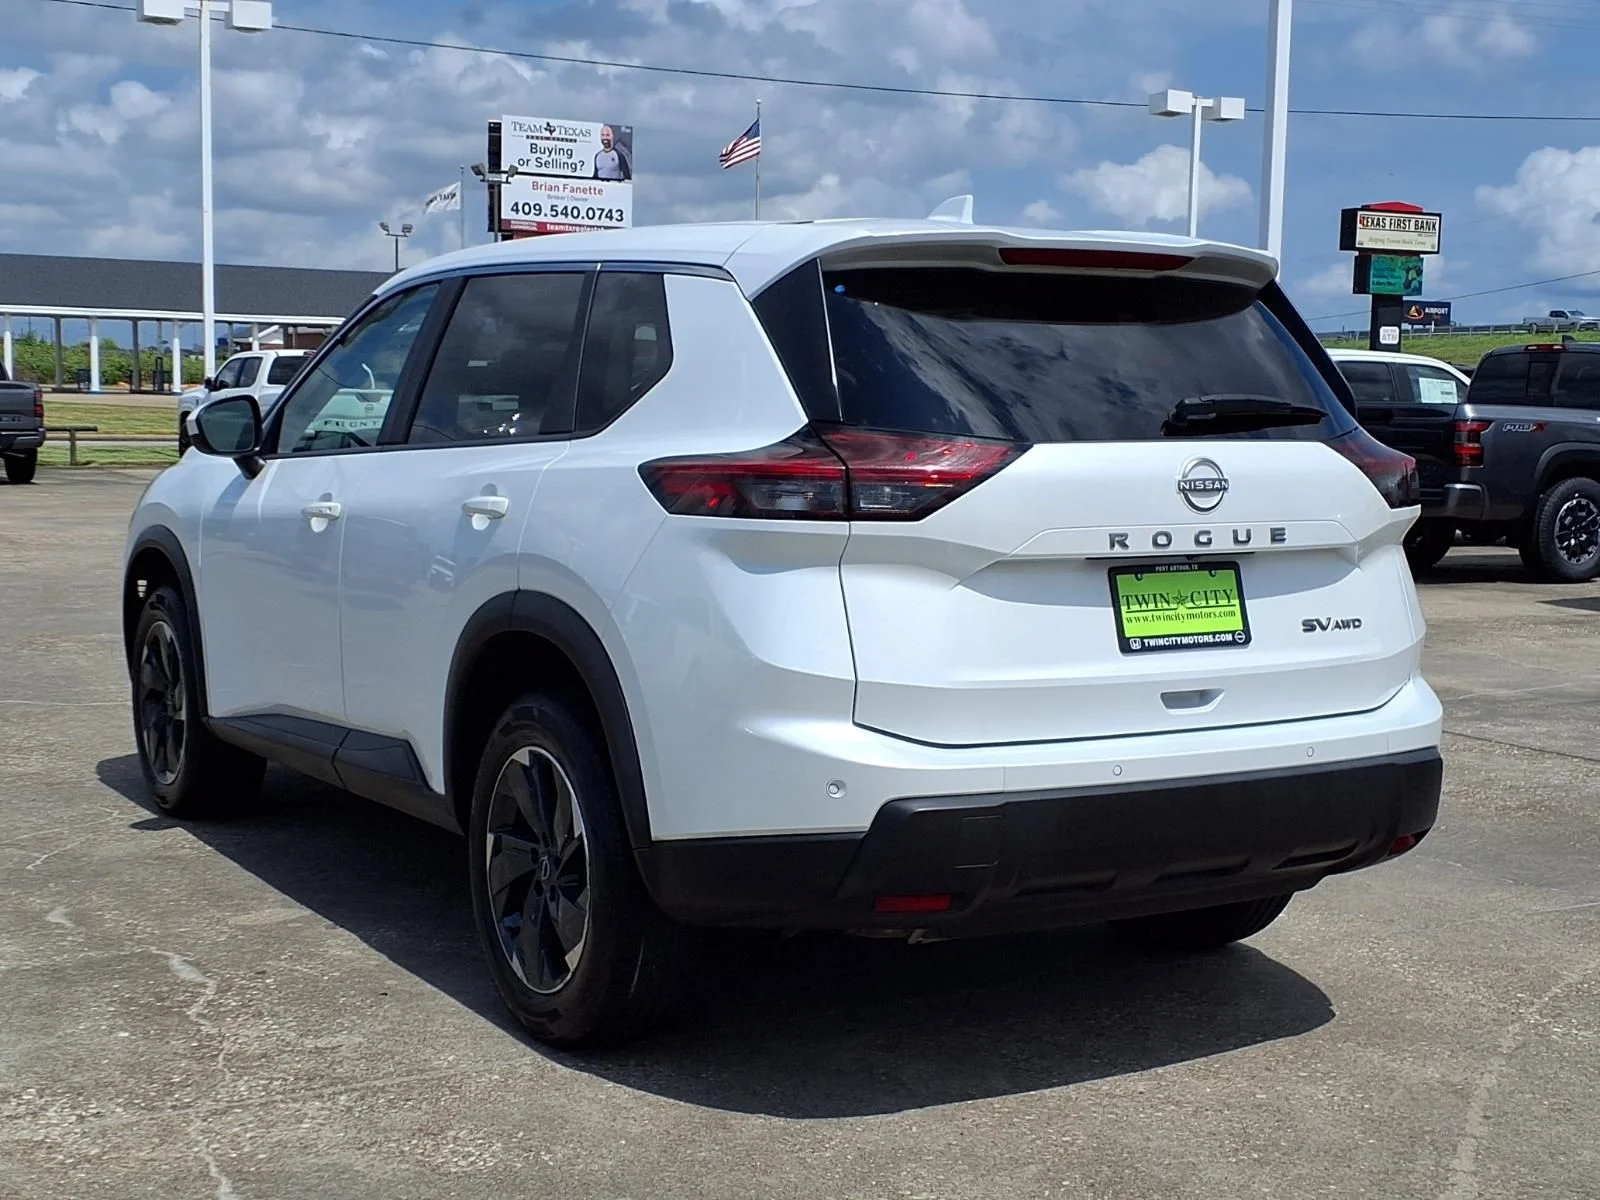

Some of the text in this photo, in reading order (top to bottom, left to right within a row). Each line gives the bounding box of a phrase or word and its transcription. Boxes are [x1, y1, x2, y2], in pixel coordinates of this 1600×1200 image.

[511, 120, 592, 138] TEAM TEXAS
[529, 142, 574, 160] Buying
[517, 157, 586, 173] or Selling?
[531, 180, 604, 196] Brian Fanette
[510, 201, 625, 222] 409.540.0743
[1361, 216, 1437, 232] TEXAS FIRST BANK
[1179, 480, 1229, 490] NISSAN
[1108, 527, 1287, 551] ROGUE
[1121, 589, 1233, 610] TWIN CITY
[1125, 610, 1236, 624] www.twincitymotors.com
[1301, 617, 1362, 633] SV AWD
[1143, 633, 1233, 647] TWINCITYMOTORS.COM
